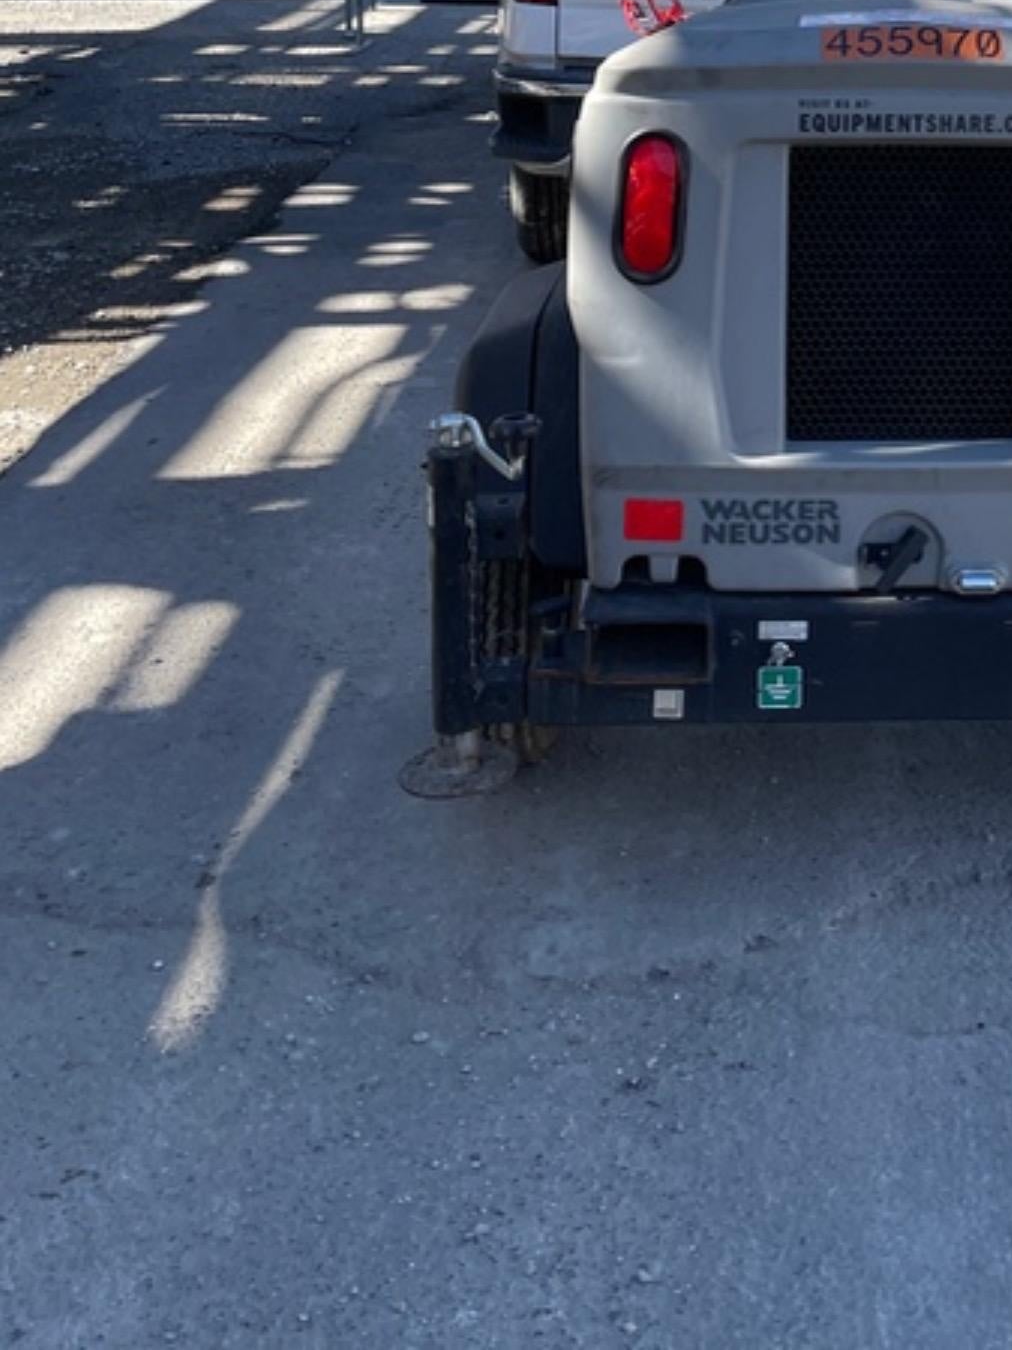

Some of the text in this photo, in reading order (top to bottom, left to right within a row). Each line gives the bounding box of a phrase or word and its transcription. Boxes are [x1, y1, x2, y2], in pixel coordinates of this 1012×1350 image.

[825, 25, 1002, 58] 455970
[700, 499, 840, 521] WACKER
[702, 522, 841, 544] NEUSON
